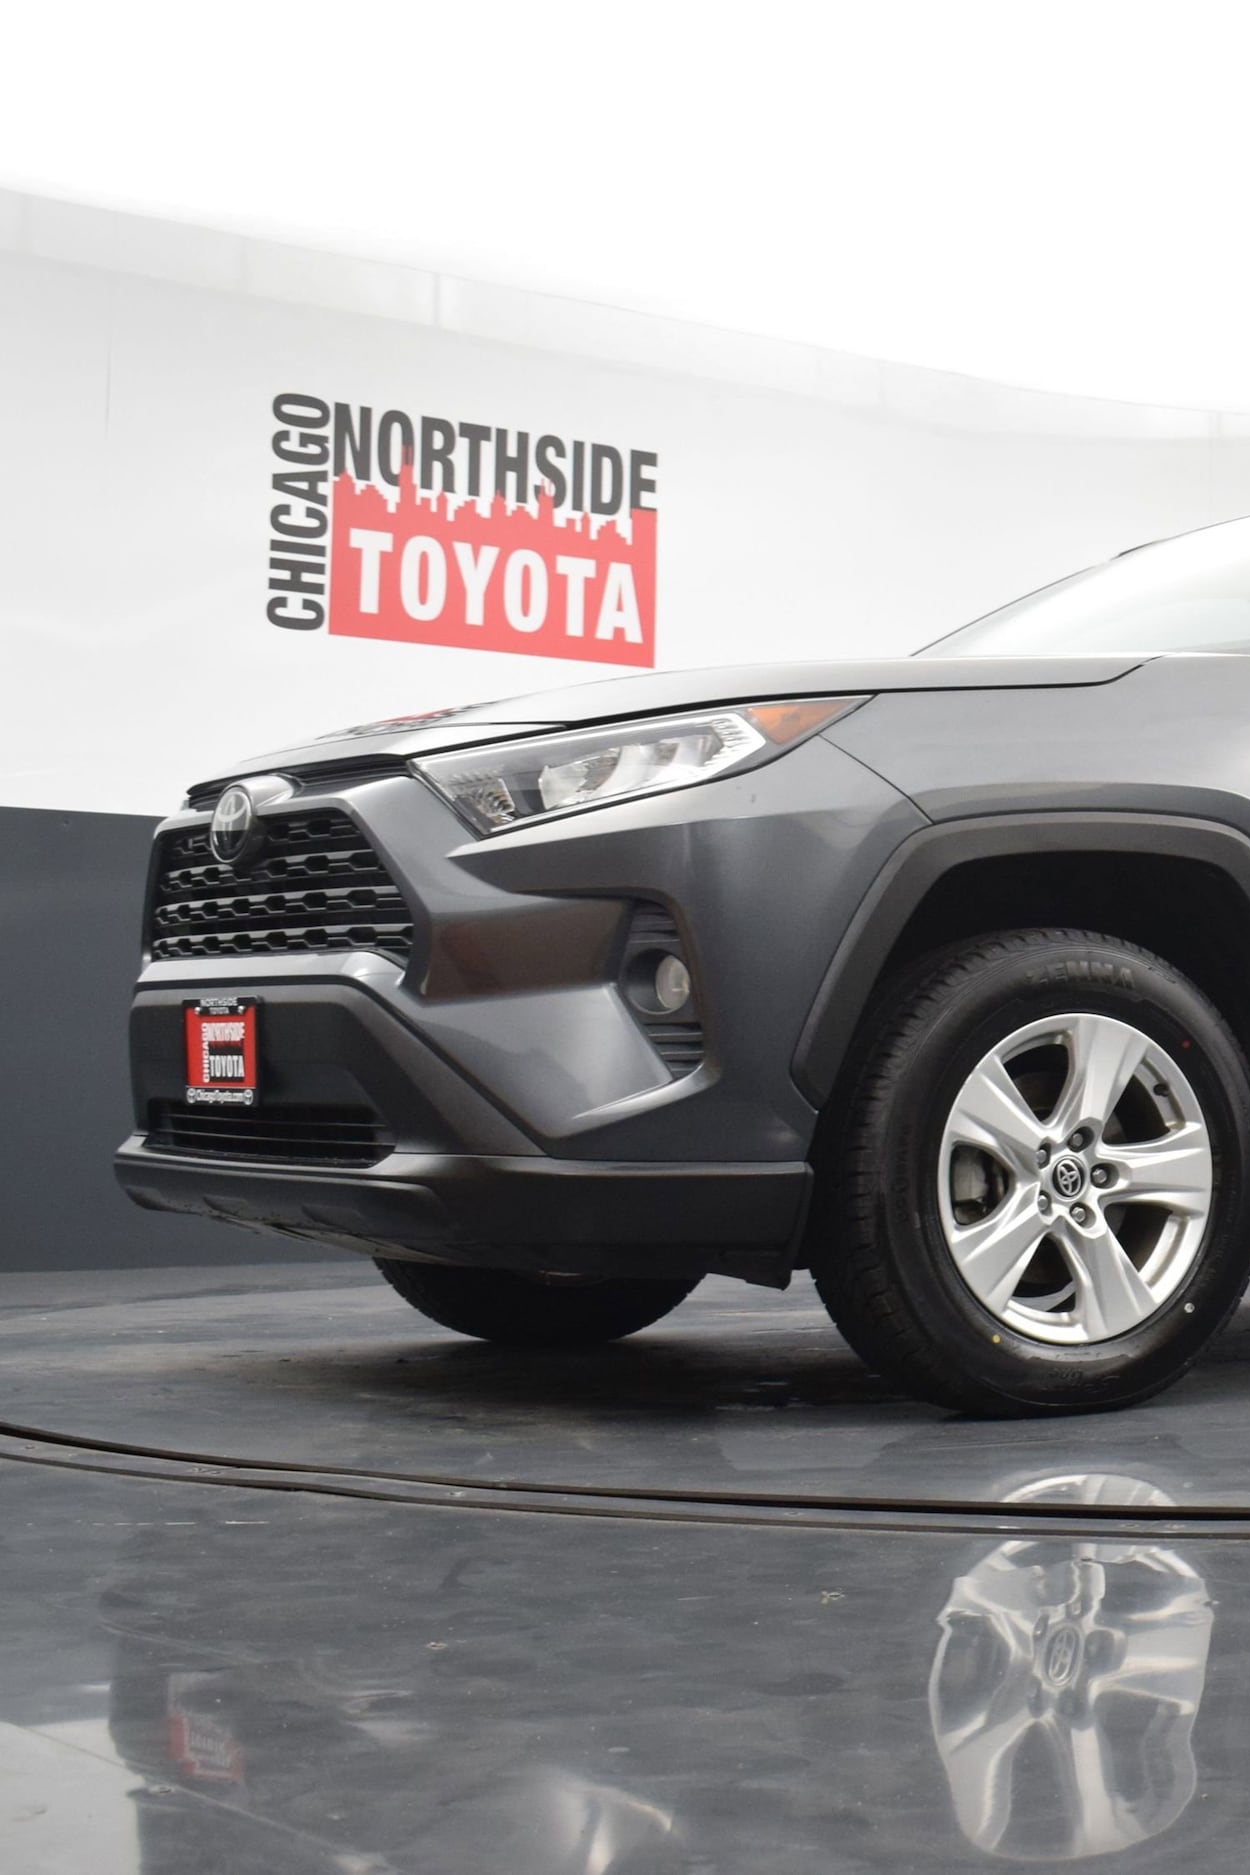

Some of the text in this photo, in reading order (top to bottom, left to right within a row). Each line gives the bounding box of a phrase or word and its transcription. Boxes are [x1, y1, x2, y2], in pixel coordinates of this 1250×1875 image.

[266, 392, 331, 632] CHICAGO
[332, 401, 658, 516] NORTHSIDE
[349, 527, 644, 644] TOYOTA
[200, 998, 238, 1006] NORTHSIDE
[209, 1055, 245, 1077] TOYOTA
